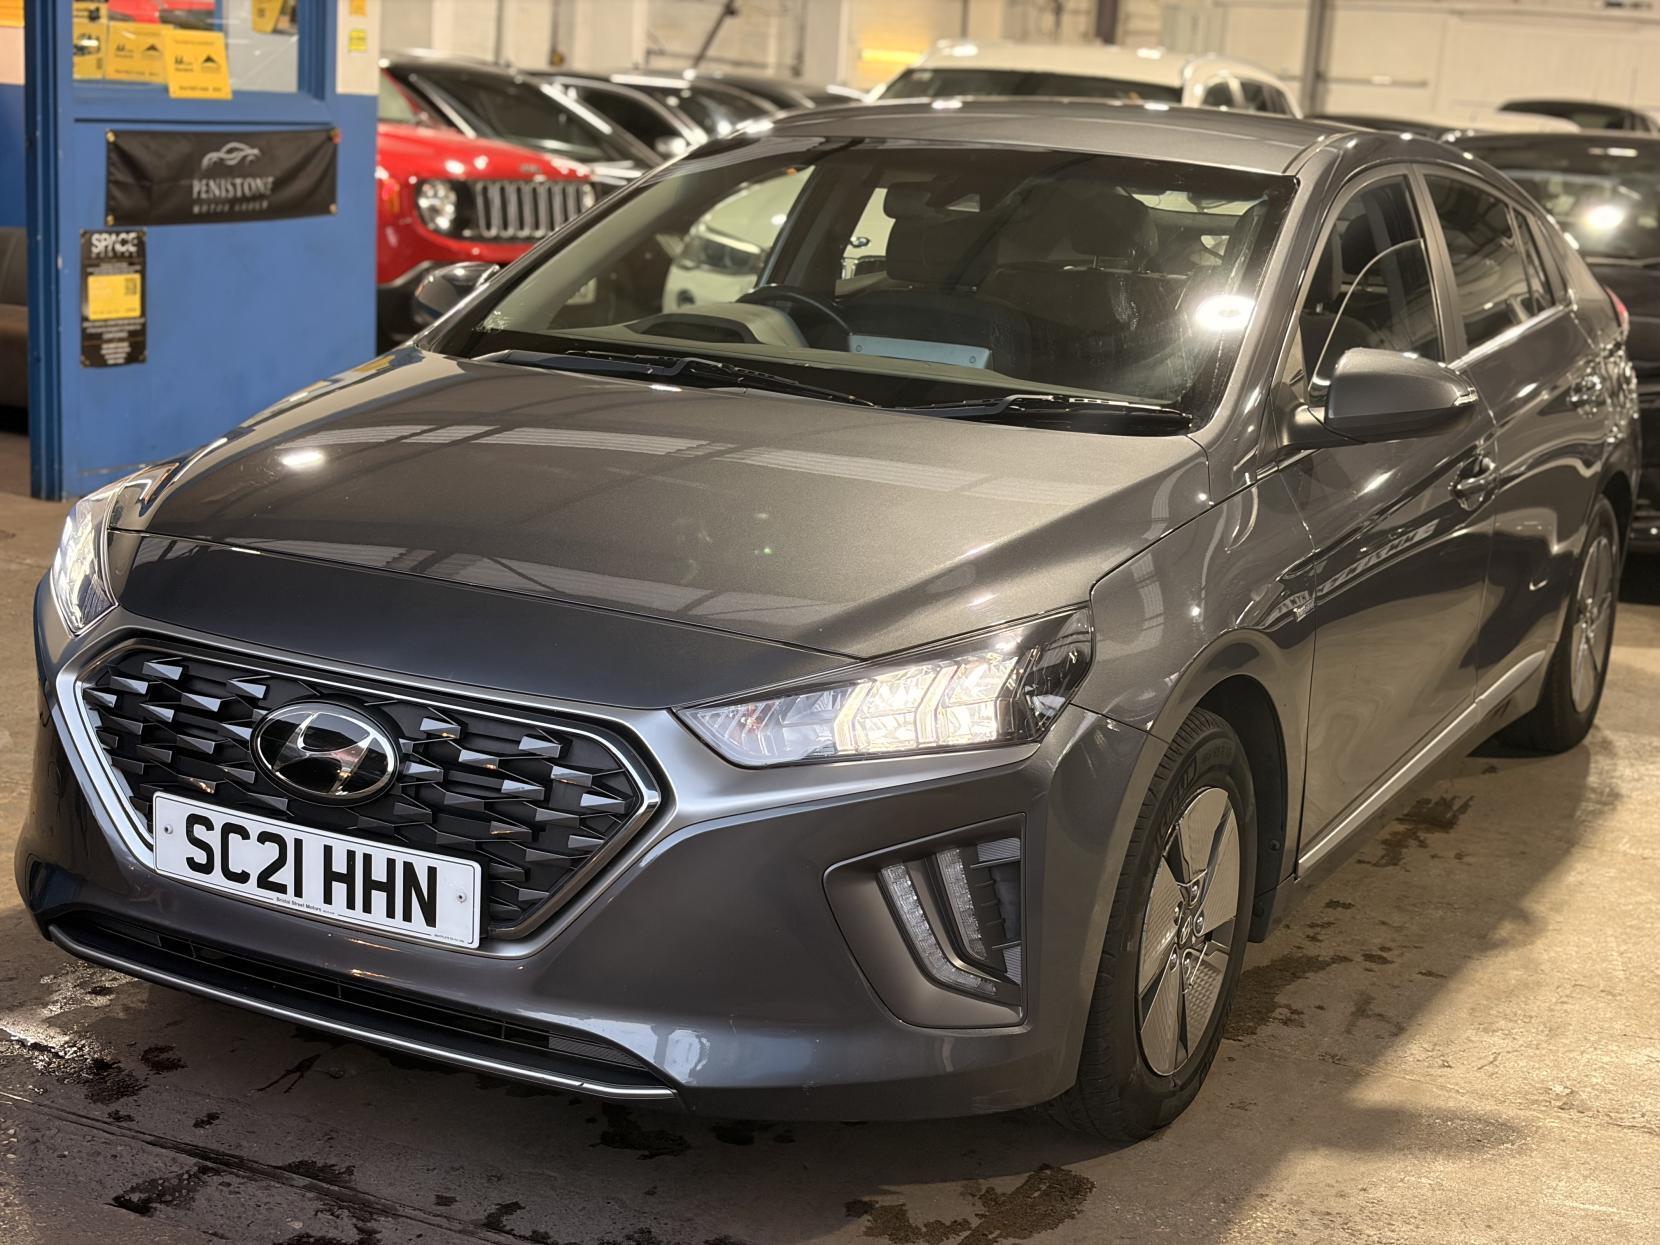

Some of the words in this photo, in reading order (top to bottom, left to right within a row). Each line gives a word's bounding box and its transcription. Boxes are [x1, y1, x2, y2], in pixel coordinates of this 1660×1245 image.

[186, 813, 303, 898] SC21
[324, 844, 437, 928] HHN
[306, 904, 321, 912] Motors
